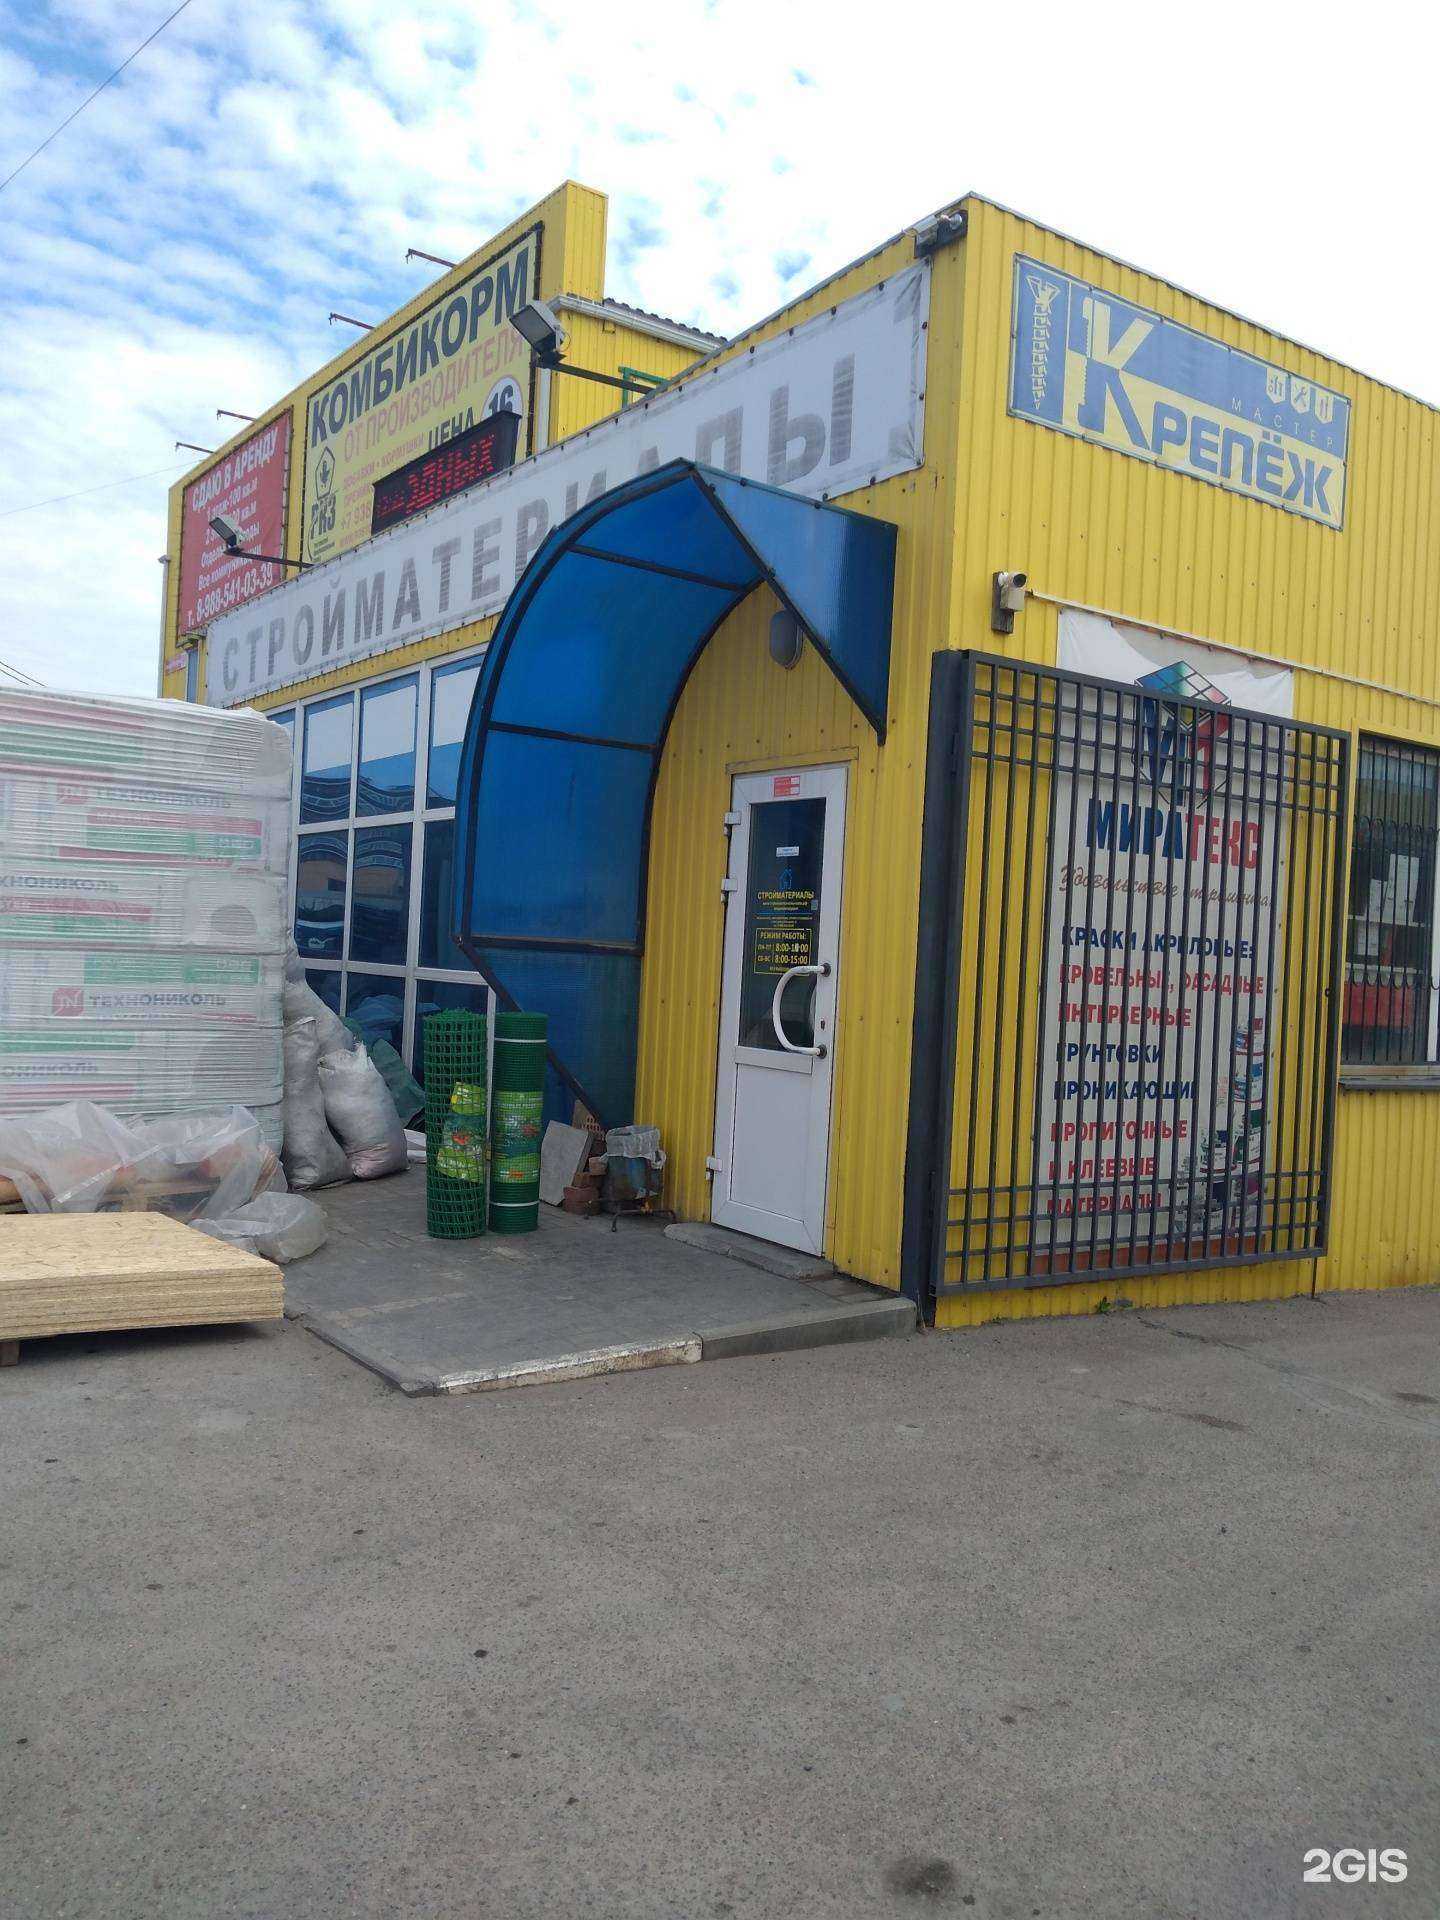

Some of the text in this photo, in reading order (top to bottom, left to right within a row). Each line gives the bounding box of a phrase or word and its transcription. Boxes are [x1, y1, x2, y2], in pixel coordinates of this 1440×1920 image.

[311, 246, 529, 448] КОМБИКОРМ
[344, 330, 522, 463] ОТ ПРОИЗВОДИТЕЛЯ
[428, 406, 474, 450] ЦЕНА
[1231, 396, 1334, 449] МАСТЕР
[192, 427, 278, 512] СДАЮ В АРЕНДУ
[222, 352, 856, 692] СТРОЙМАТЕРЛЫ
[1086, 798, 1262, 869] МИРАТЕКС
[1061, 926, 1137, 951] КРАСКИ
[89, 993, 227, 1009] ТЕХНОНИКОЛЬ
